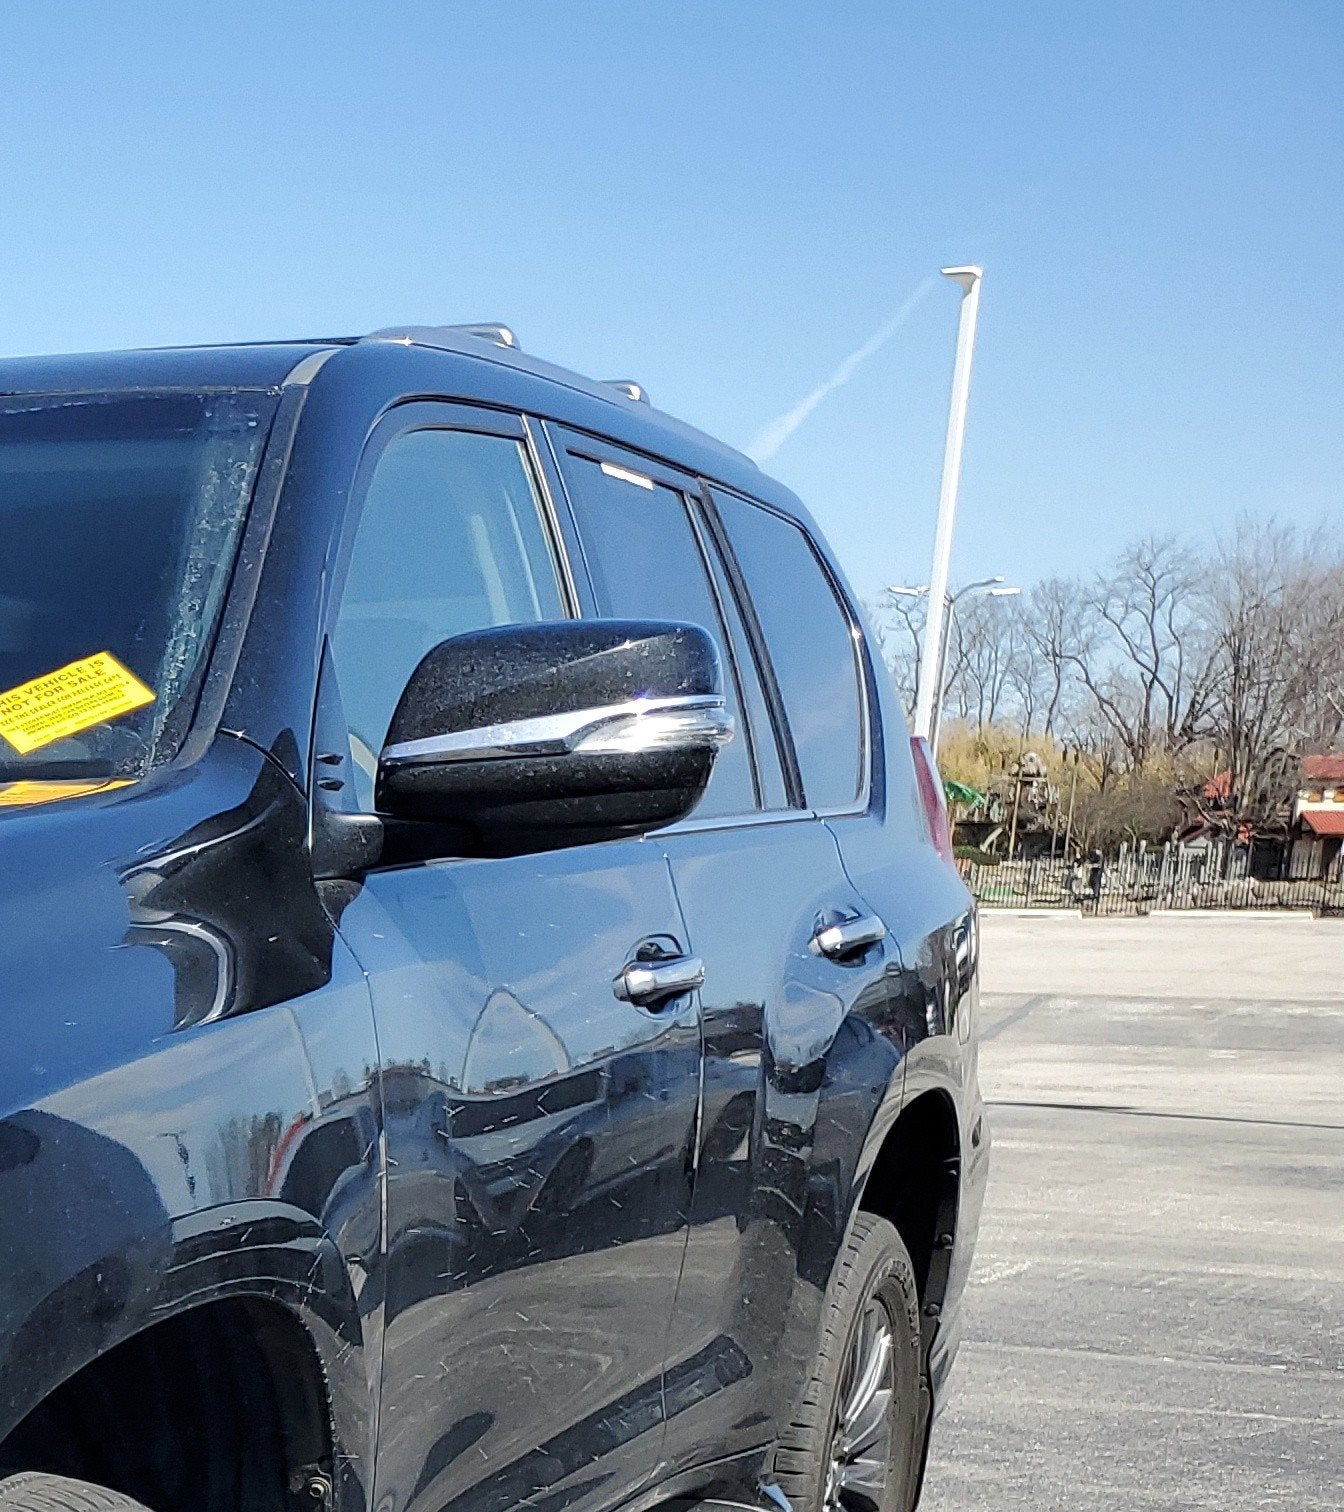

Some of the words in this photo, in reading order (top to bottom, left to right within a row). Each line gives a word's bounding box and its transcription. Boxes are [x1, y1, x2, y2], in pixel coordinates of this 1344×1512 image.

[0, 698, 30, 716] NOT
[34, 685, 65, 701] FOR
[67, 668, 107, 688] SALE
[23, 666, 86, 695] VEHICLE
[88, 659, 104, 669] IS
